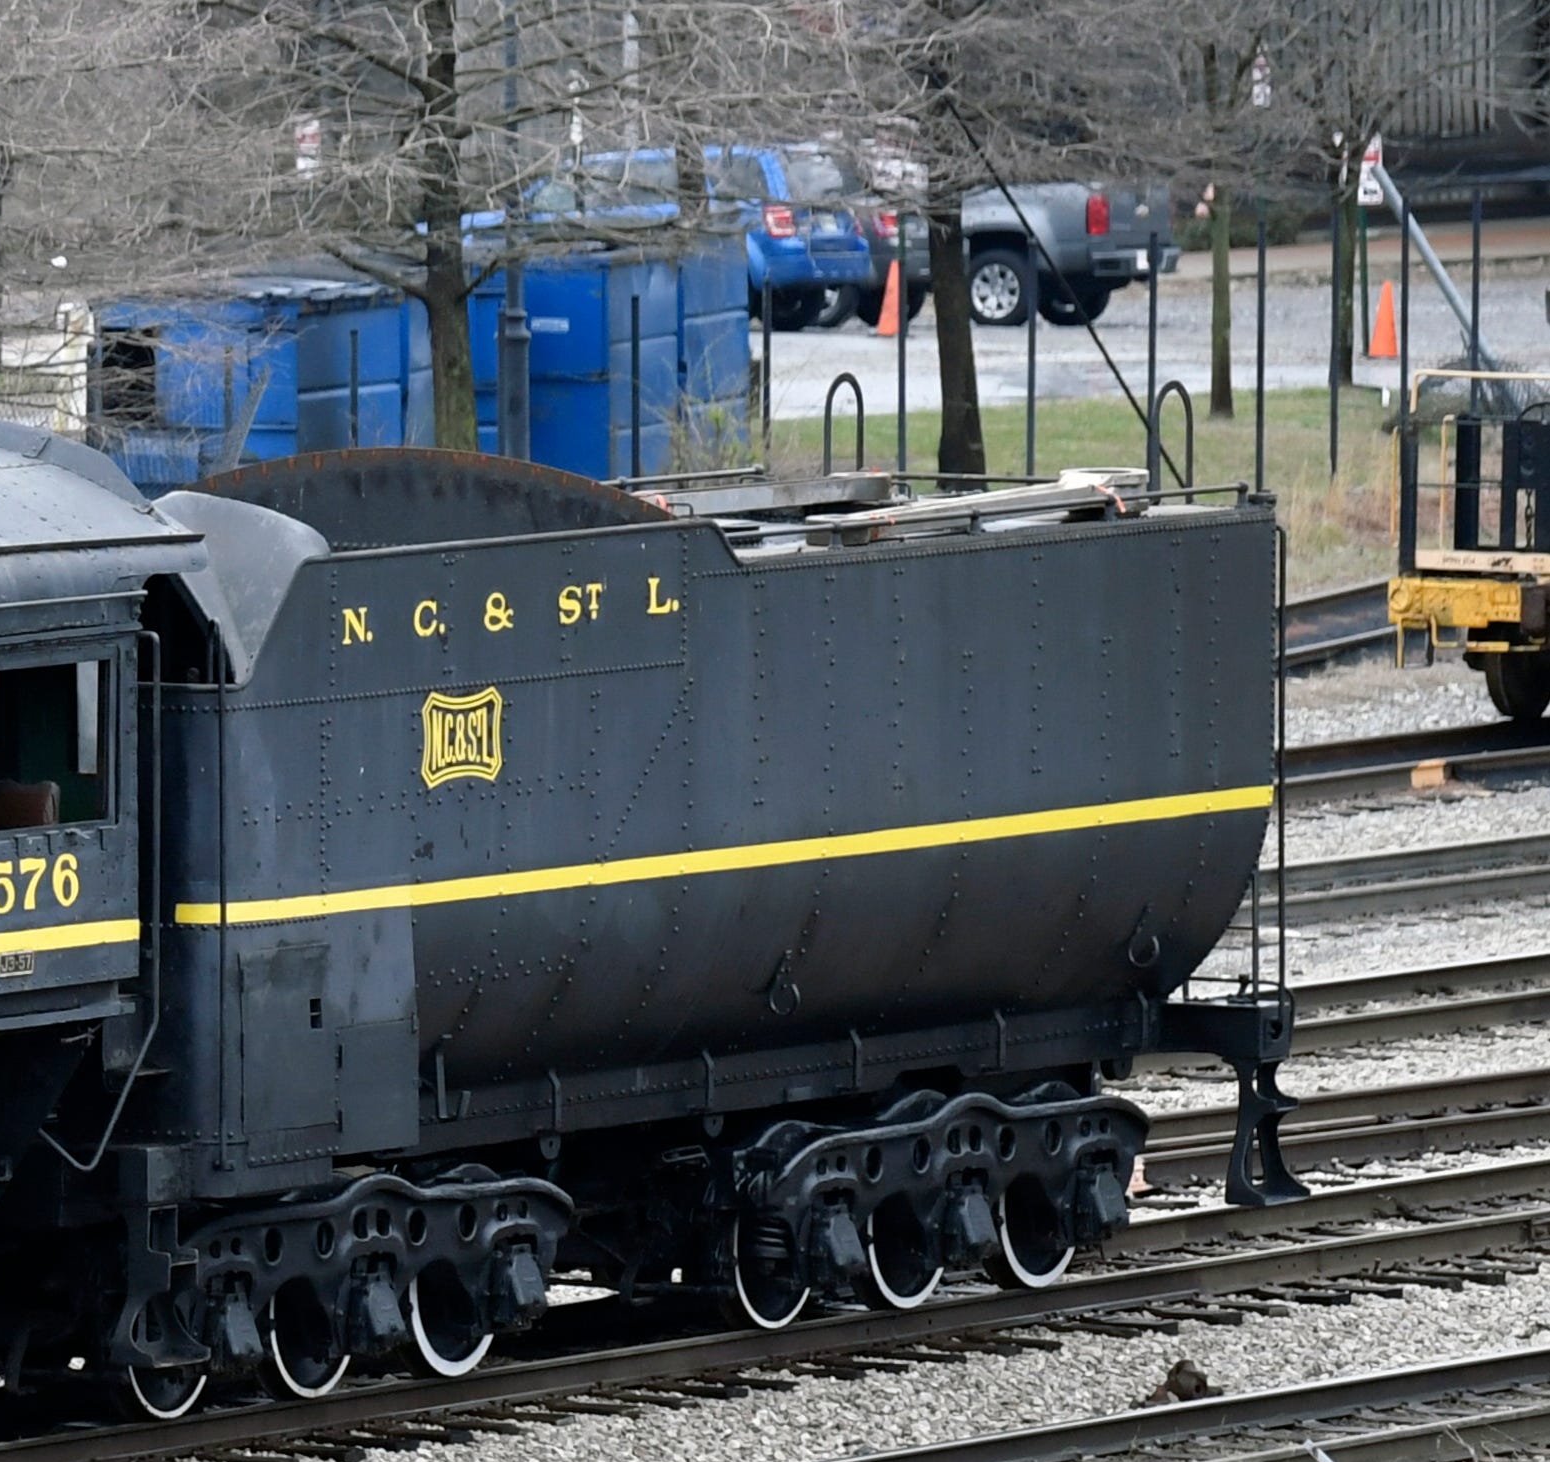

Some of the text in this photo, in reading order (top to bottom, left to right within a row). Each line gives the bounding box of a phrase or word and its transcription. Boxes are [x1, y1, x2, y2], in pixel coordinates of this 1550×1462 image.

[342, 607, 374, 645] N.
[413, 600, 445, 637] C.
[484, 592, 514, 632] &
[647, 577, 680, 614] L.
